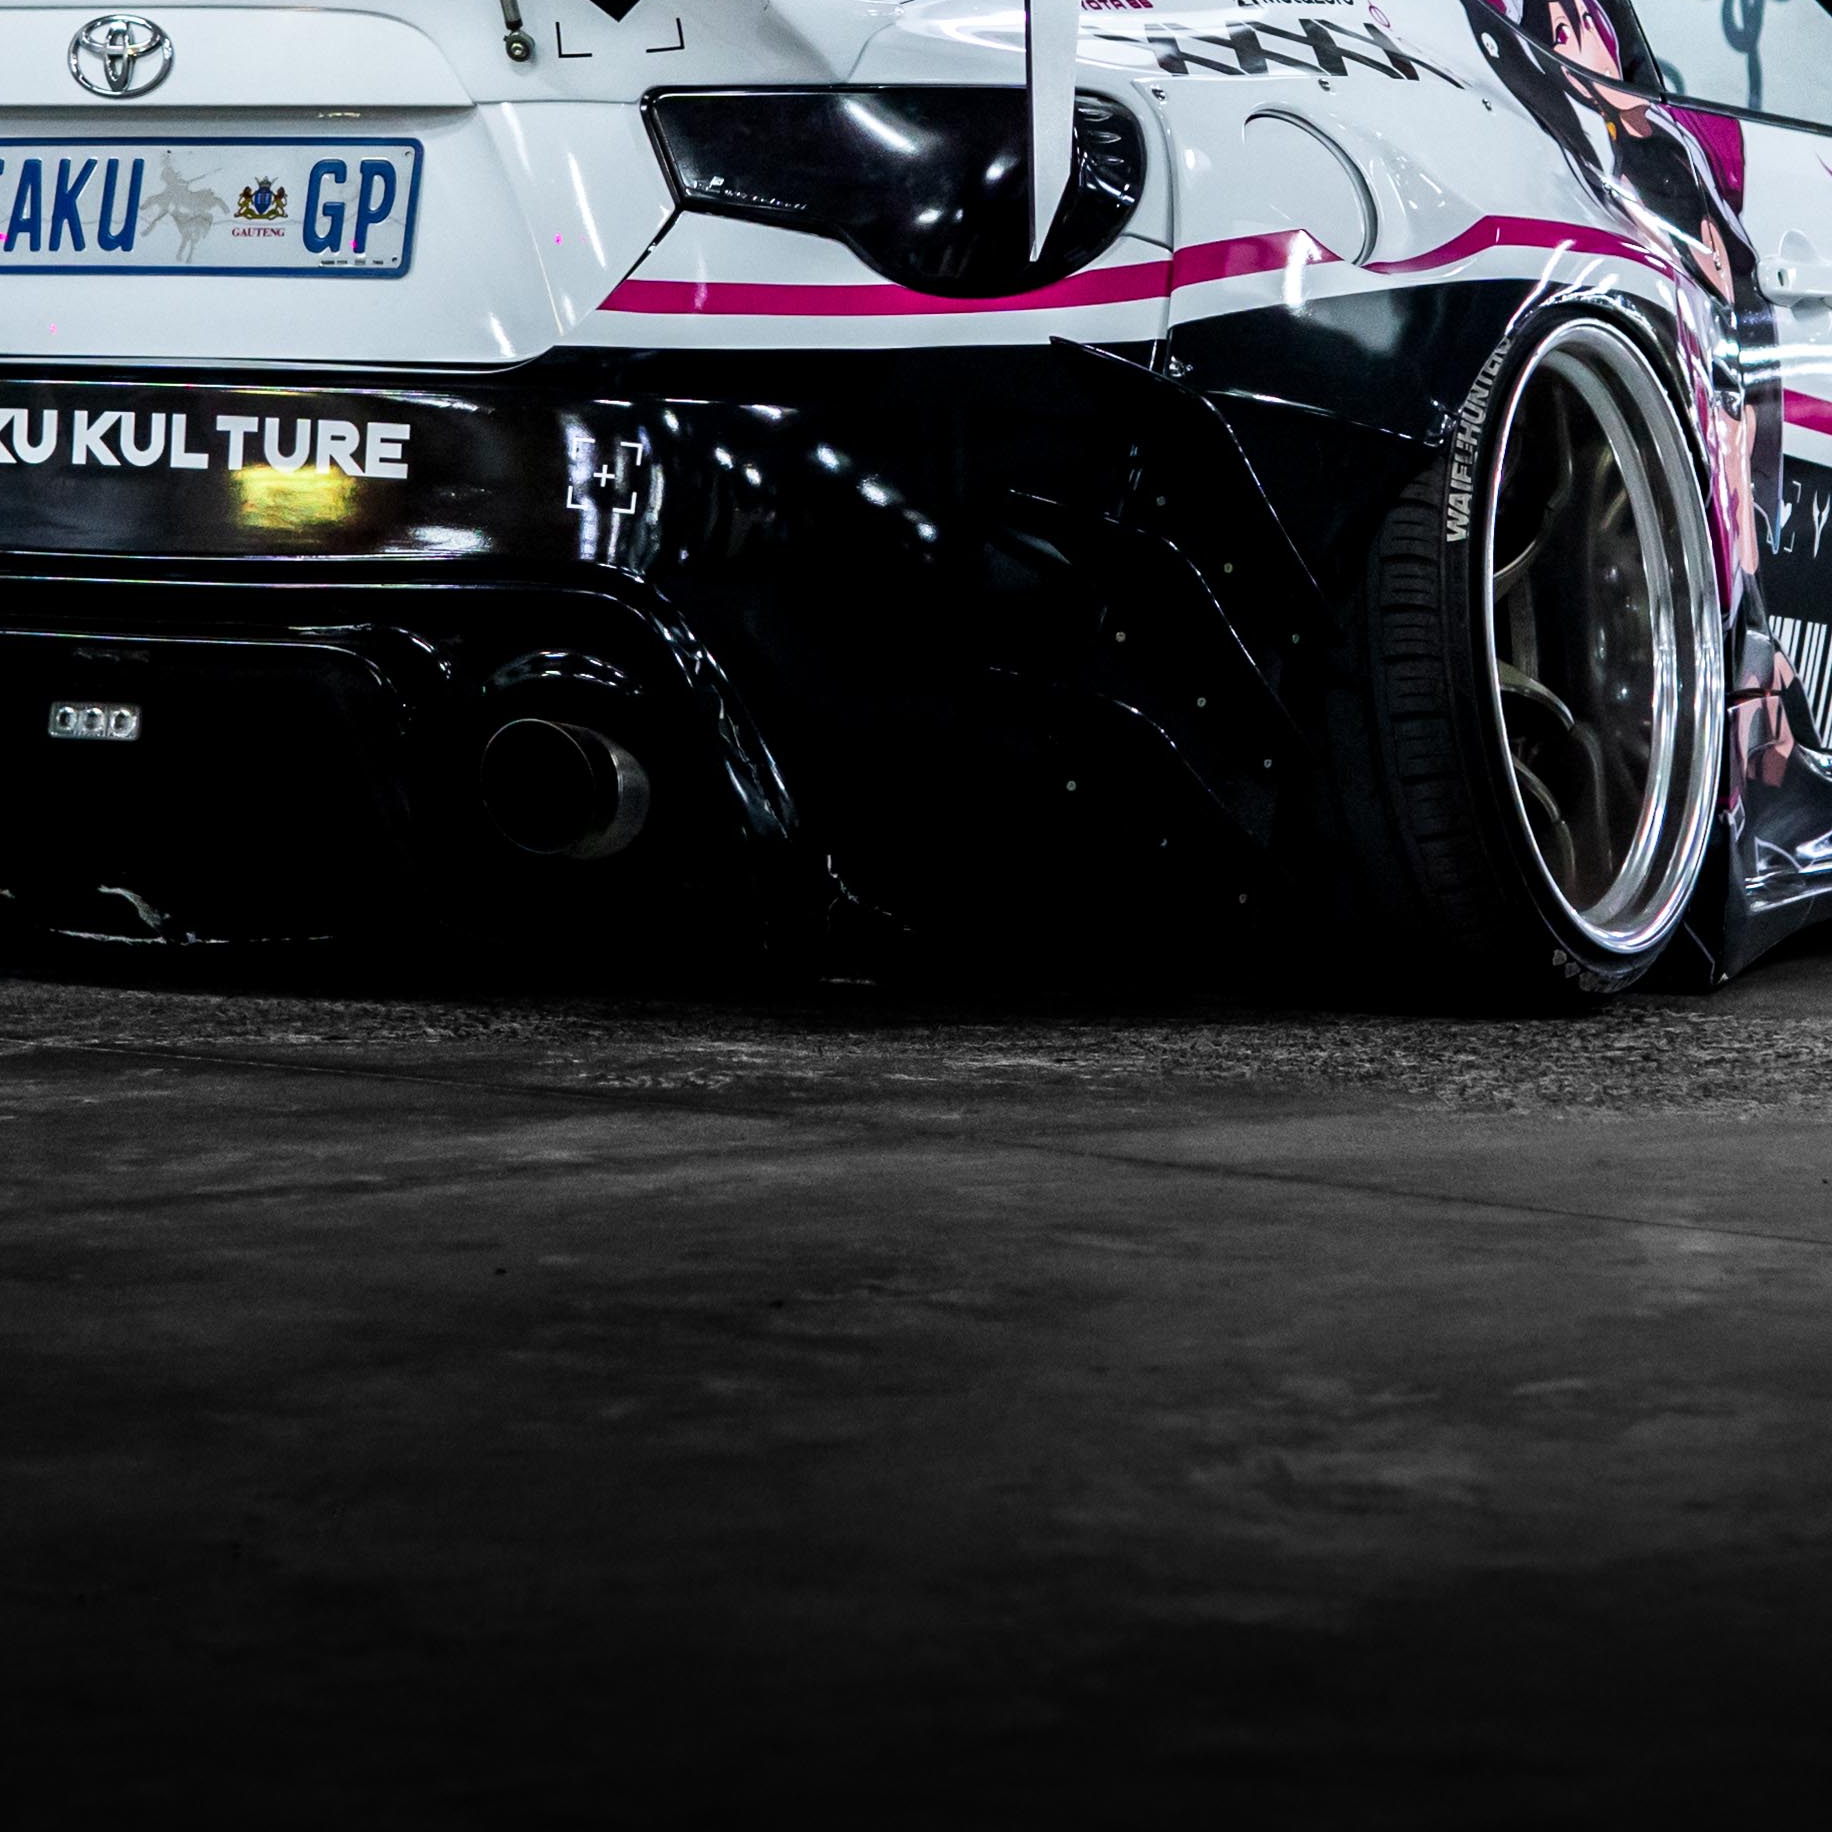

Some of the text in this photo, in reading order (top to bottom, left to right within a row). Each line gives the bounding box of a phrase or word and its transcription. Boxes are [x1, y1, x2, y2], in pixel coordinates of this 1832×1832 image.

[232, 227, 285, 237] GAUTENG
[302, 159, 397, 254] GP
[72, 410, 411, 479] KULTURE
